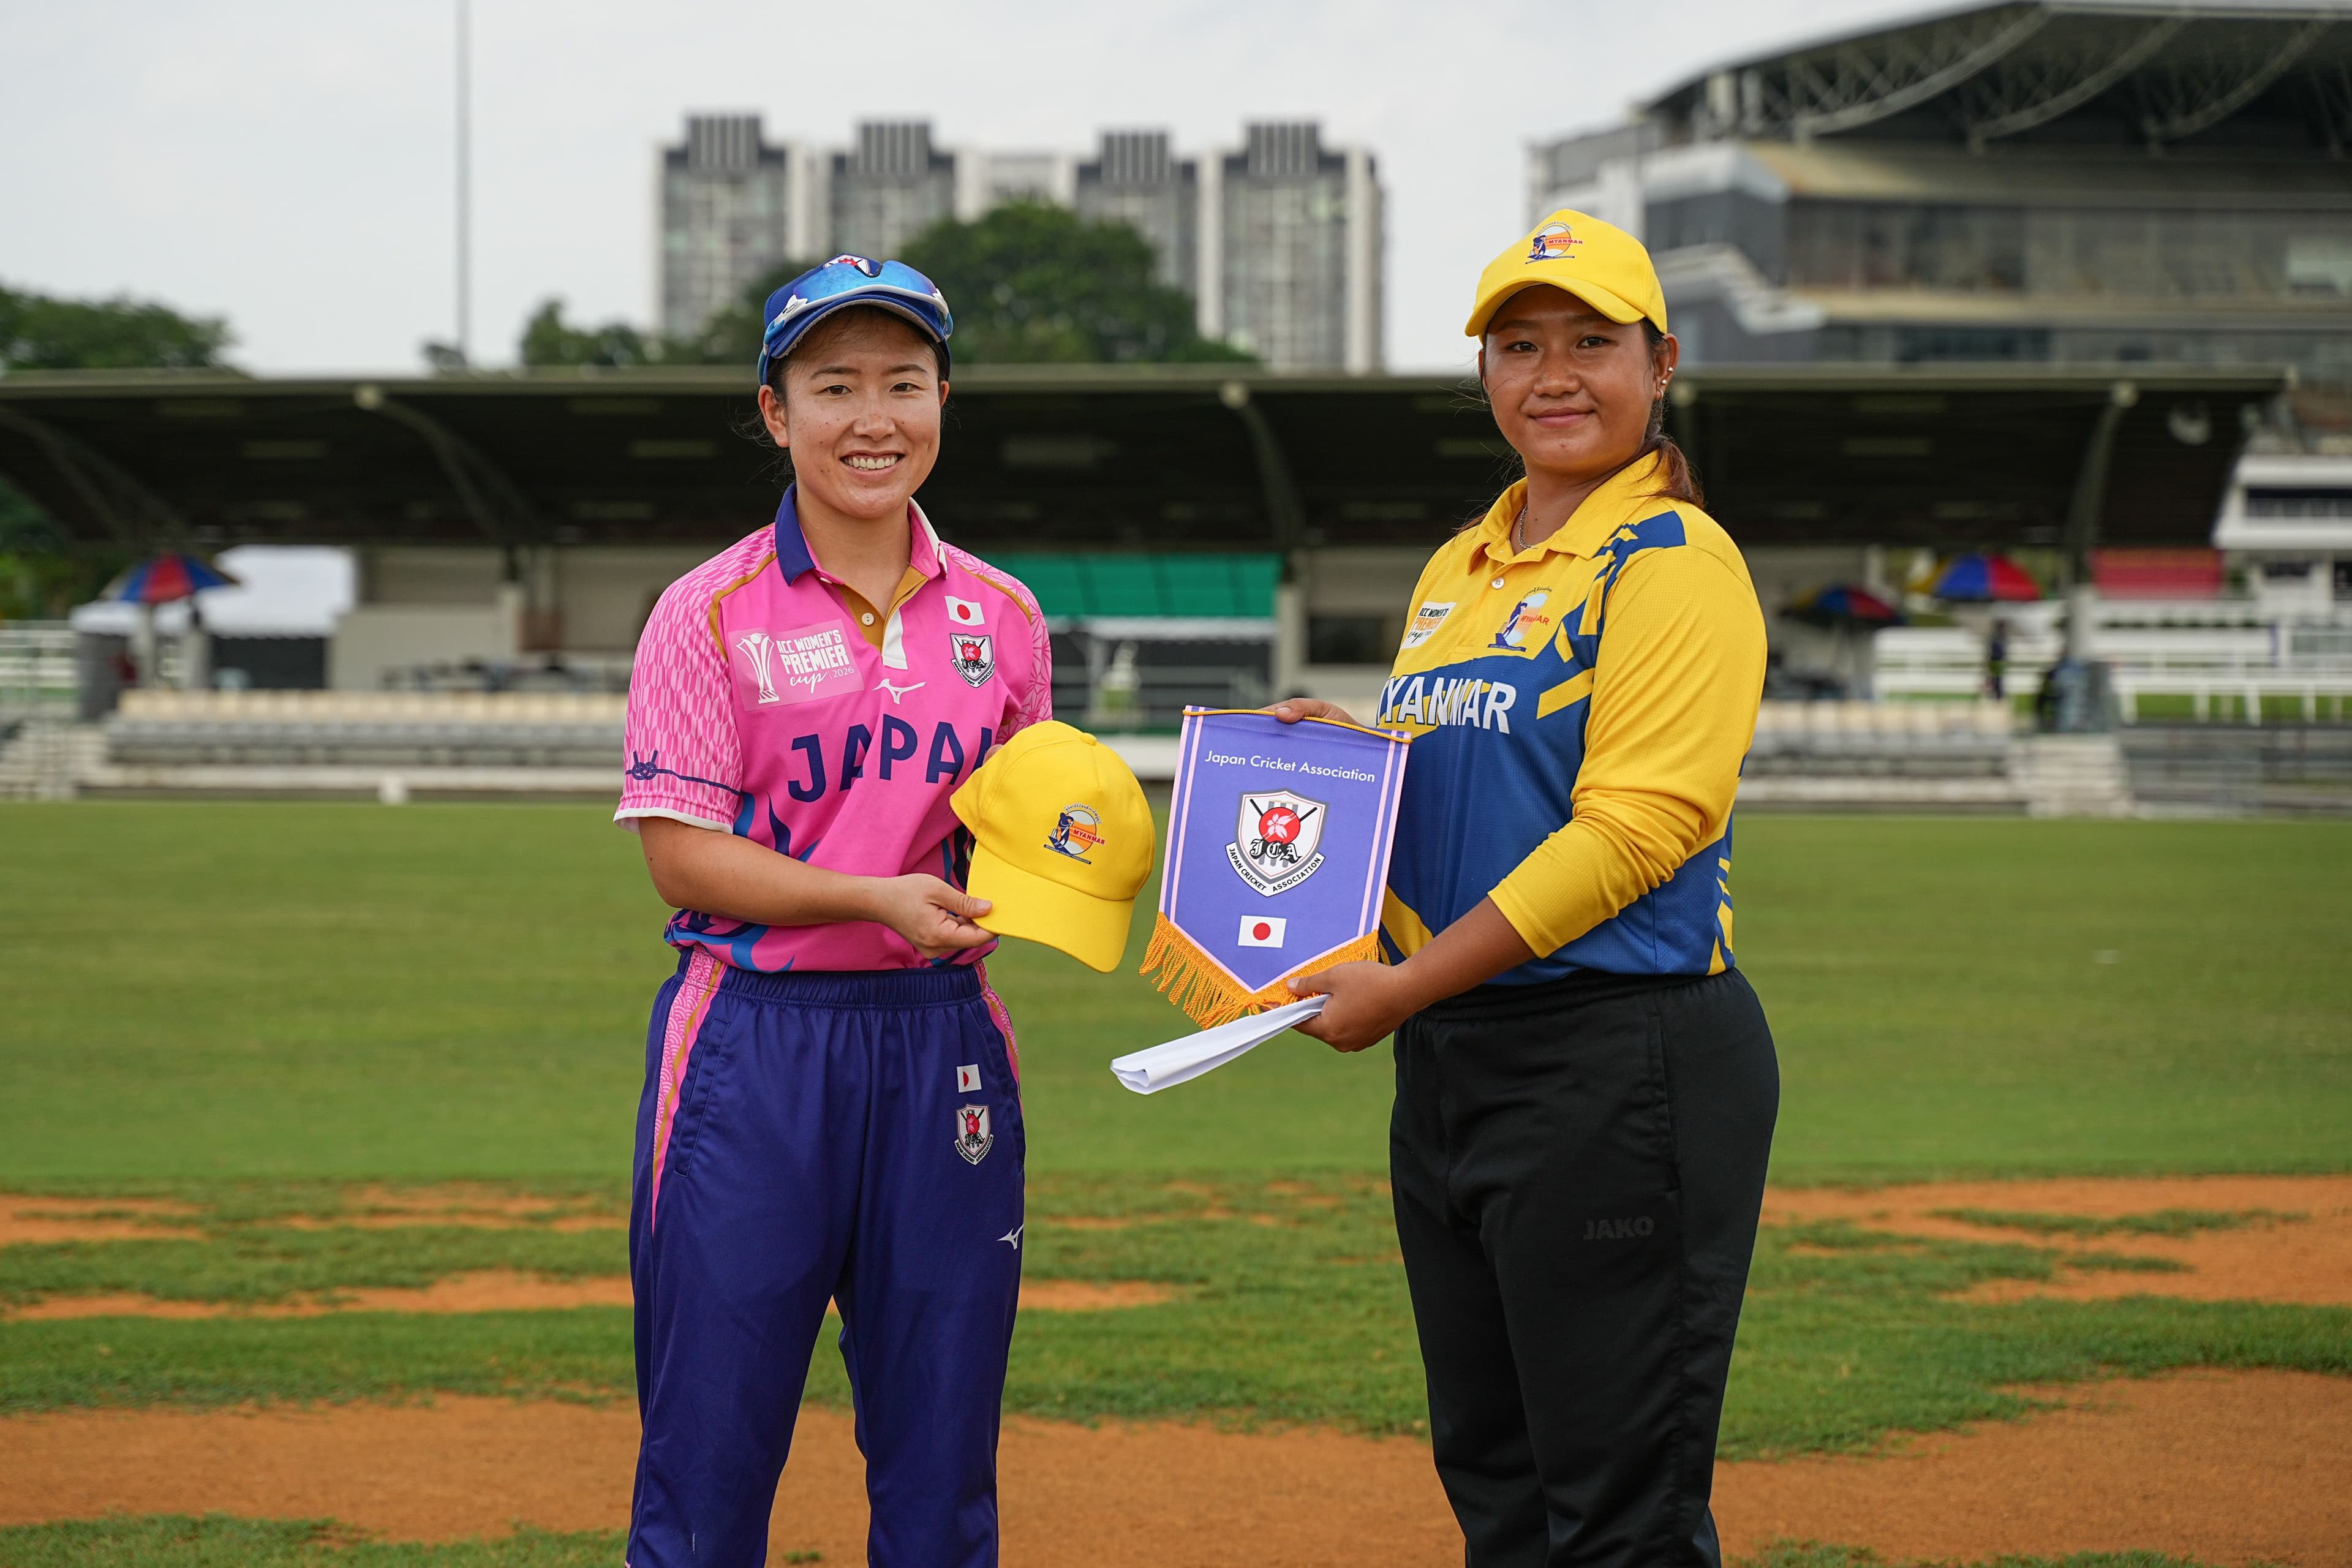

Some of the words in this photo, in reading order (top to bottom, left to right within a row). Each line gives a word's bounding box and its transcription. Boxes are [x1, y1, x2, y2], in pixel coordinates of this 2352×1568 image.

[776, 640, 795, 654] ACC
[794, 630, 842, 652] WOMEN'S
[780, 644, 850, 675] PREMIER
[790, 672, 827, 694] cup
[832, 667, 854, 679] 2026
[1205, 750, 1246, 766] Japan
[1250, 755, 1297, 772] Cricket
[1298, 762, 1376, 782] Association
[1072, 829, 1106, 845] MYANMAR
[1250, 839, 1303, 864] JCA
[1229, 848, 1242, 870] JAPAN
[1241, 867, 1267, 891] CRICKET
[1273, 858, 1322, 892] ASSOCIATION
[1583, 1216, 1654, 1240] JAKO
